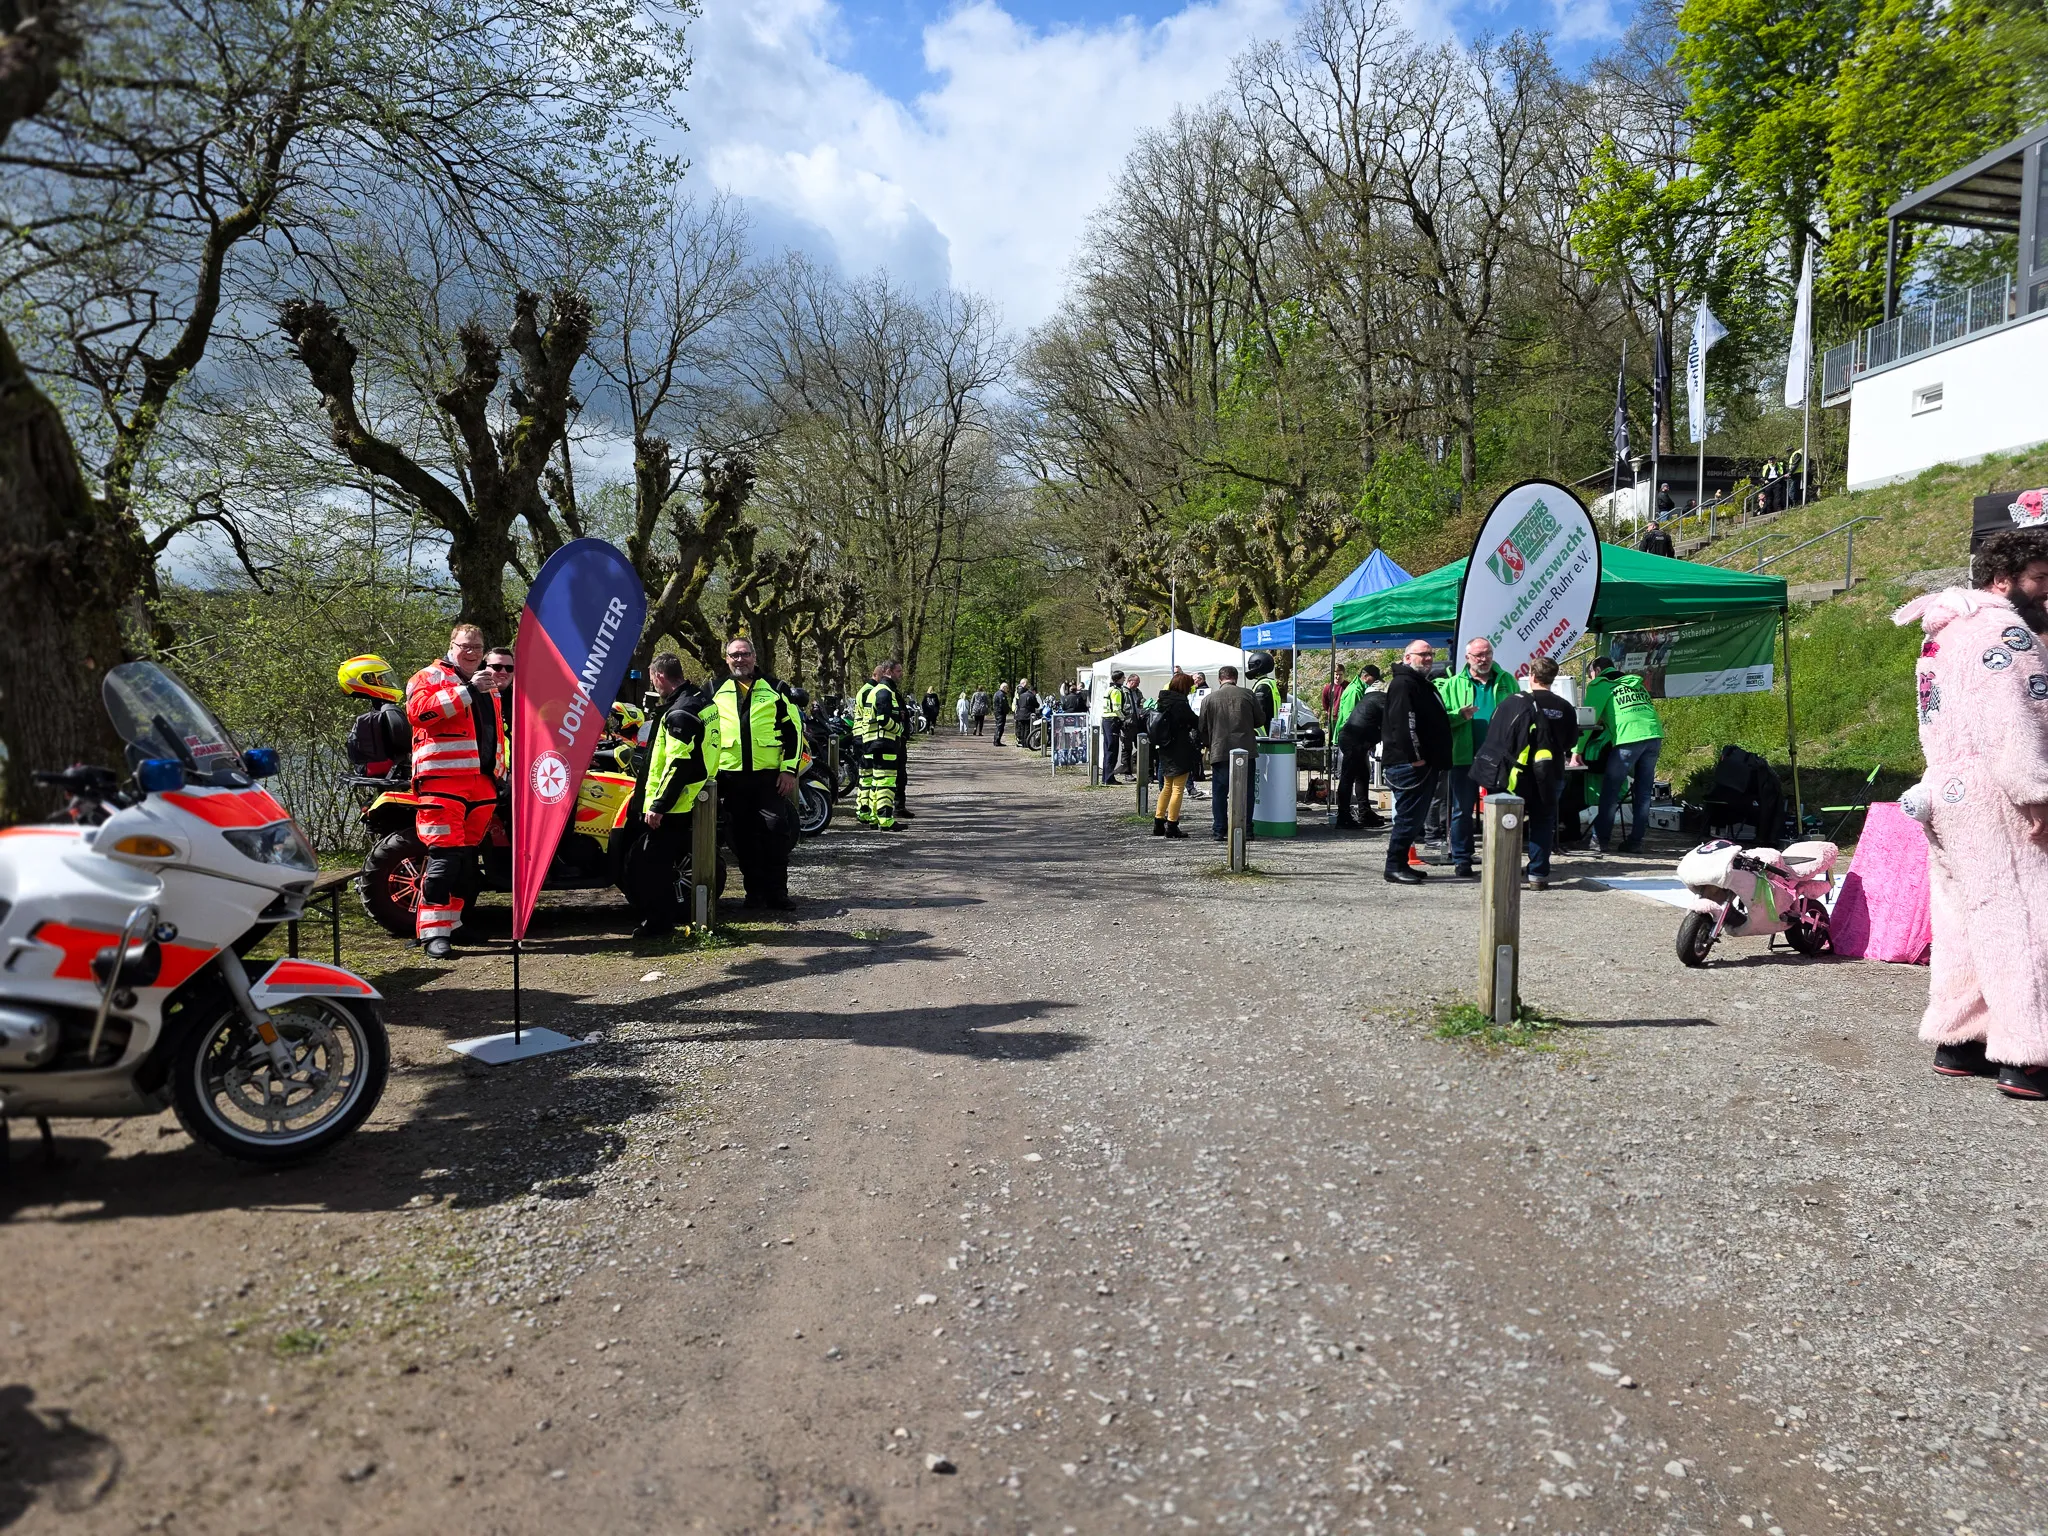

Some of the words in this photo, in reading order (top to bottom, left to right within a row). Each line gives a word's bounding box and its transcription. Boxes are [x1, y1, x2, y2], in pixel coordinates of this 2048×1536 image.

[1512, 502, 1548, 546] VERKEHRS
[1518, 522, 1545, 555] WACHT
[1530, 524, 1563, 565] ENNEPE-RUHR
[1486, 525, 1587, 649] is-Verkehrswacht
[1516, 571, 1575, 642] Ennepe-Ruhr
[1573, 549, 1591, 574] e.V.
[1529, 617, 1571, 660] Jahren
[1553, 629, 1578, 661] uhr-Kreis
[1681, 625, 1716, 639] Sicherheit
[557, 596, 628, 747] JOHANNITER
[1616, 693, 1645, 706] WACHT
